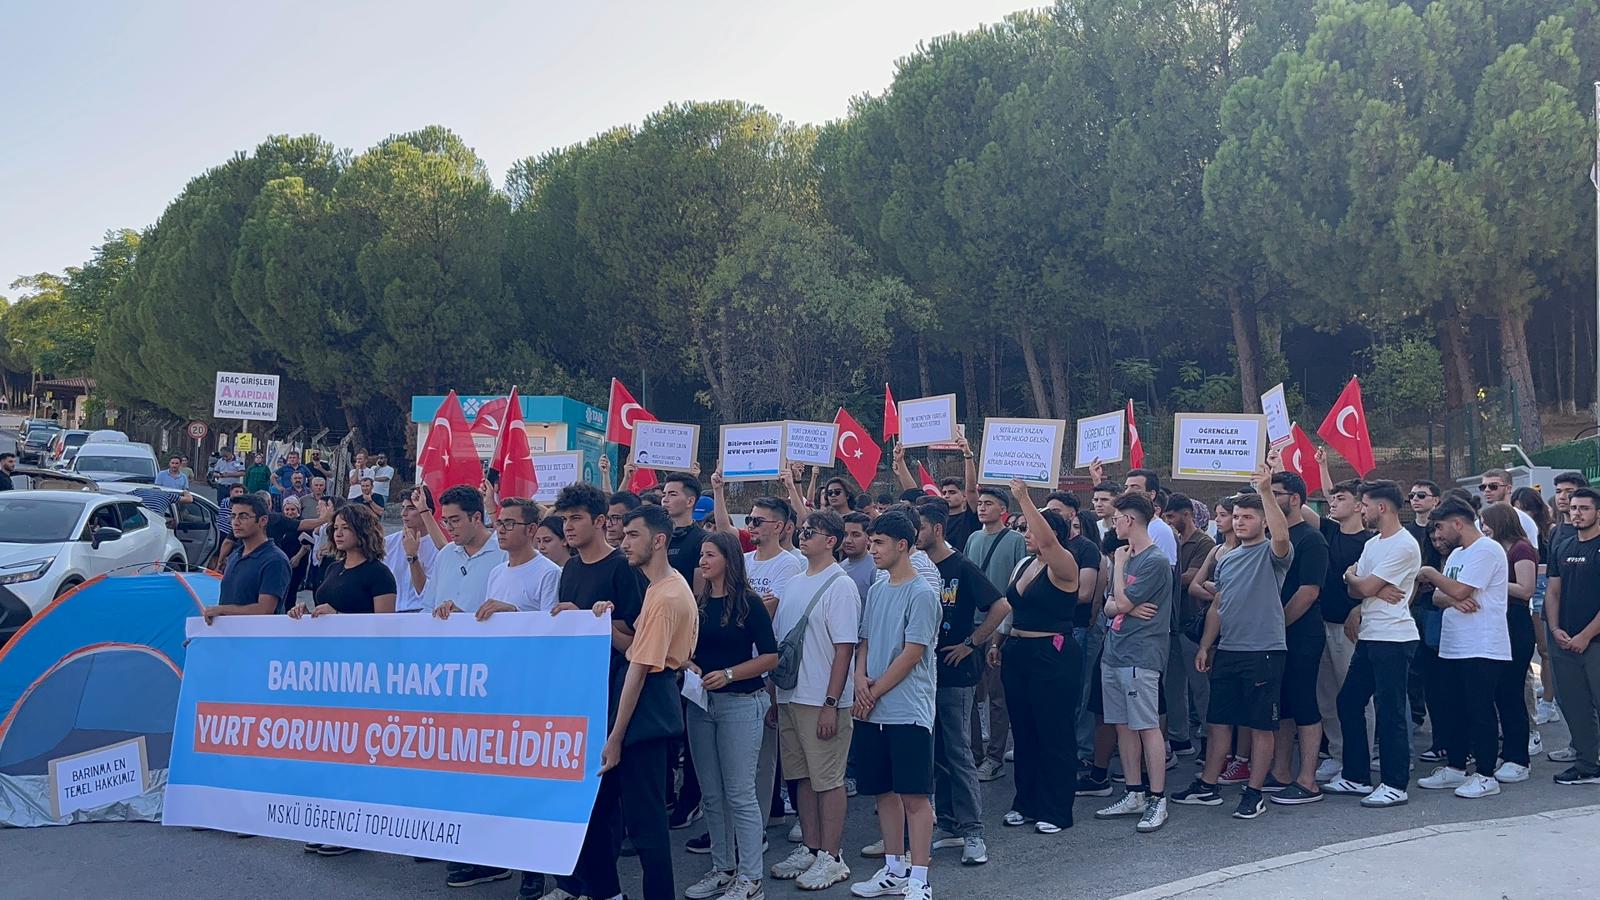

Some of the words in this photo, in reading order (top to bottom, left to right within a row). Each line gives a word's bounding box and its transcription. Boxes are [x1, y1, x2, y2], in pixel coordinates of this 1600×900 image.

[220, 376, 239, 386] ARAÇ
[241, 376, 275, 386] GİRİŞLERİ
[221, 384, 232, 398] A
[234, 390, 274, 400] KAPIDAN
[219, 400, 274, 408] YAPILMAKTADIR
[192, 426, 203, 435] 20
[268, 660, 381, 694] BARINMA
[387, 662, 488, 697] HAKTIR
[198, 714, 256, 746] YURT
[256, 717, 359, 754] SORUNU
[365, 715, 584, 769] ÇÖZÜLMELİDİR!
[72, 762, 111, 781] BARINMA
[114, 758, 126, 770] EN
[64, 782, 92, 799] TEMEL
[95, 770, 136, 791] HAKKIMIZ
[267, 802, 300, 826] MSKÜ
[304, 803, 361, 833] ÖĞRENCİ
[365, 814, 462, 845] TOPLULUKLARI
